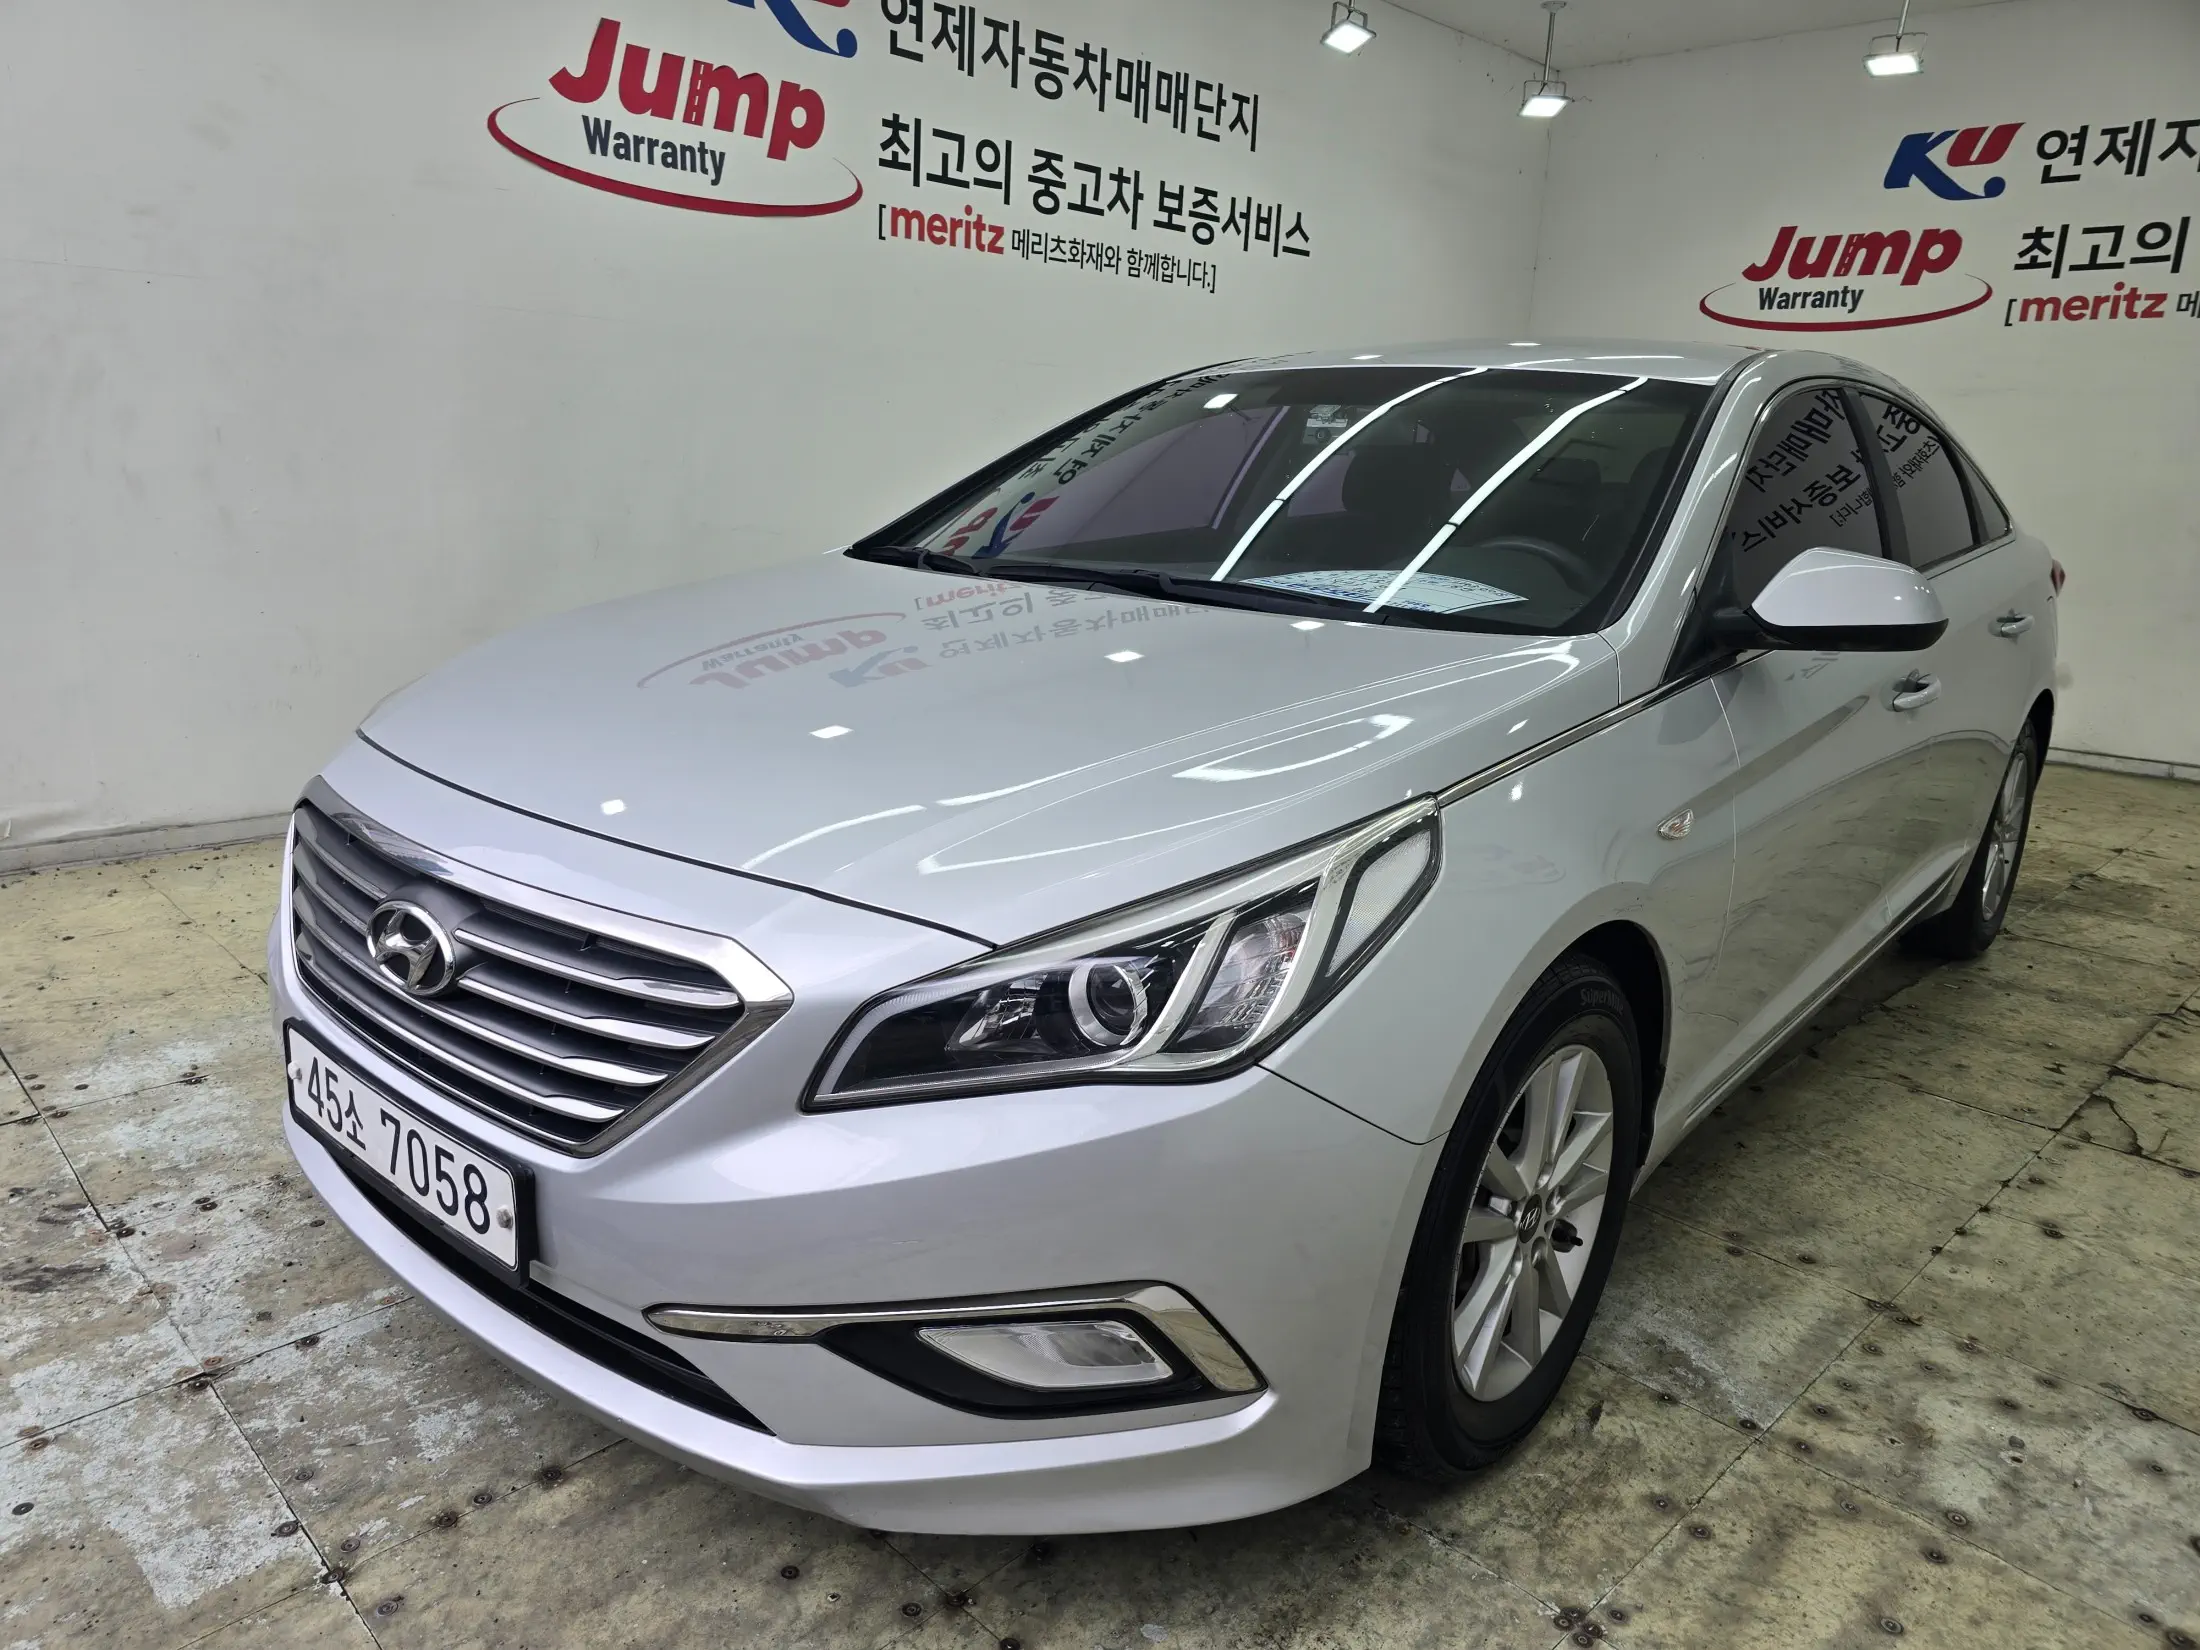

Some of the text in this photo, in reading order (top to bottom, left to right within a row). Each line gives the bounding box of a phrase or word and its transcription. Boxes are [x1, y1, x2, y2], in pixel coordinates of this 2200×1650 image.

[548, 17, 826, 161] Jump
[881, 0, 1259, 152] 연제자동차매매단지
[581, 115, 726, 186] Warranty
[878, 112, 1311, 257] 최고의 중고차 보증서비스
[1011, 228, 1122, 274] 메리츠화재와
[1741, 225, 1963, 286] Jump
[2013, 216, 2191, 279] 최고의
[1758, 285, 1865, 313] Warranty
[307, 1057, 490, 1234] 45소 7058
